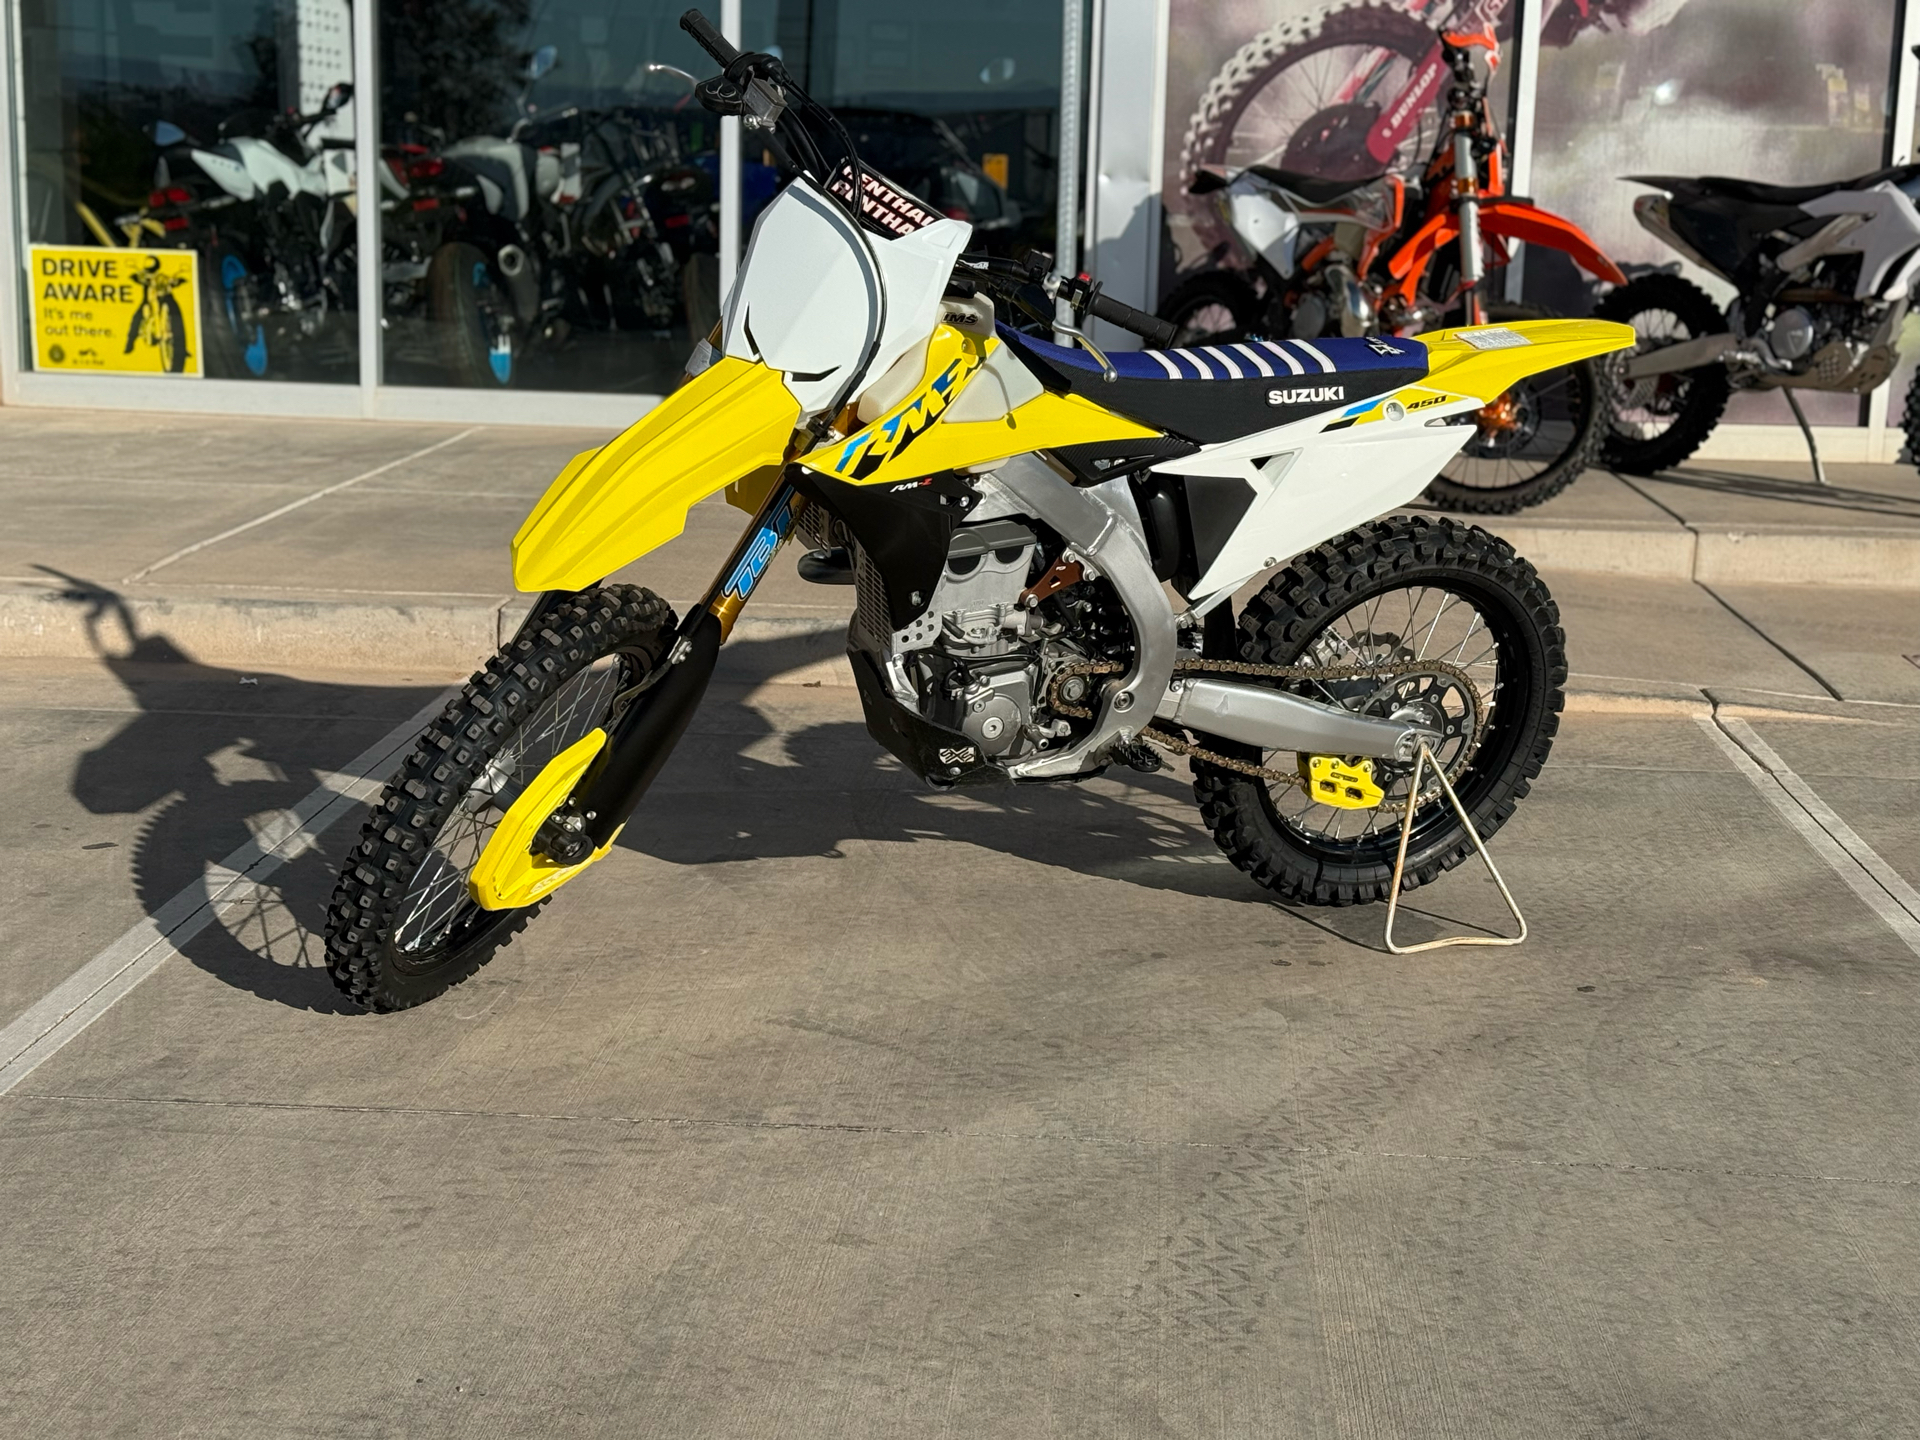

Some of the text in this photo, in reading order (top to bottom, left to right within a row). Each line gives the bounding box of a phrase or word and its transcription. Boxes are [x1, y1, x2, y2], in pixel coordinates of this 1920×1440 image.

[1390, 62, 1437, 129] DUNLOP
[42, 257, 119, 279] DRIVE
[43, 282, 135, 303] AWARE
[44, 307, 93, 321] It's me
[943, 312, 979, 325] IMS
[45, 325, 68, 336] out
[1268, 386, 1345, 405] SUZUKI
[1406, 394, 1448, 410] 450
